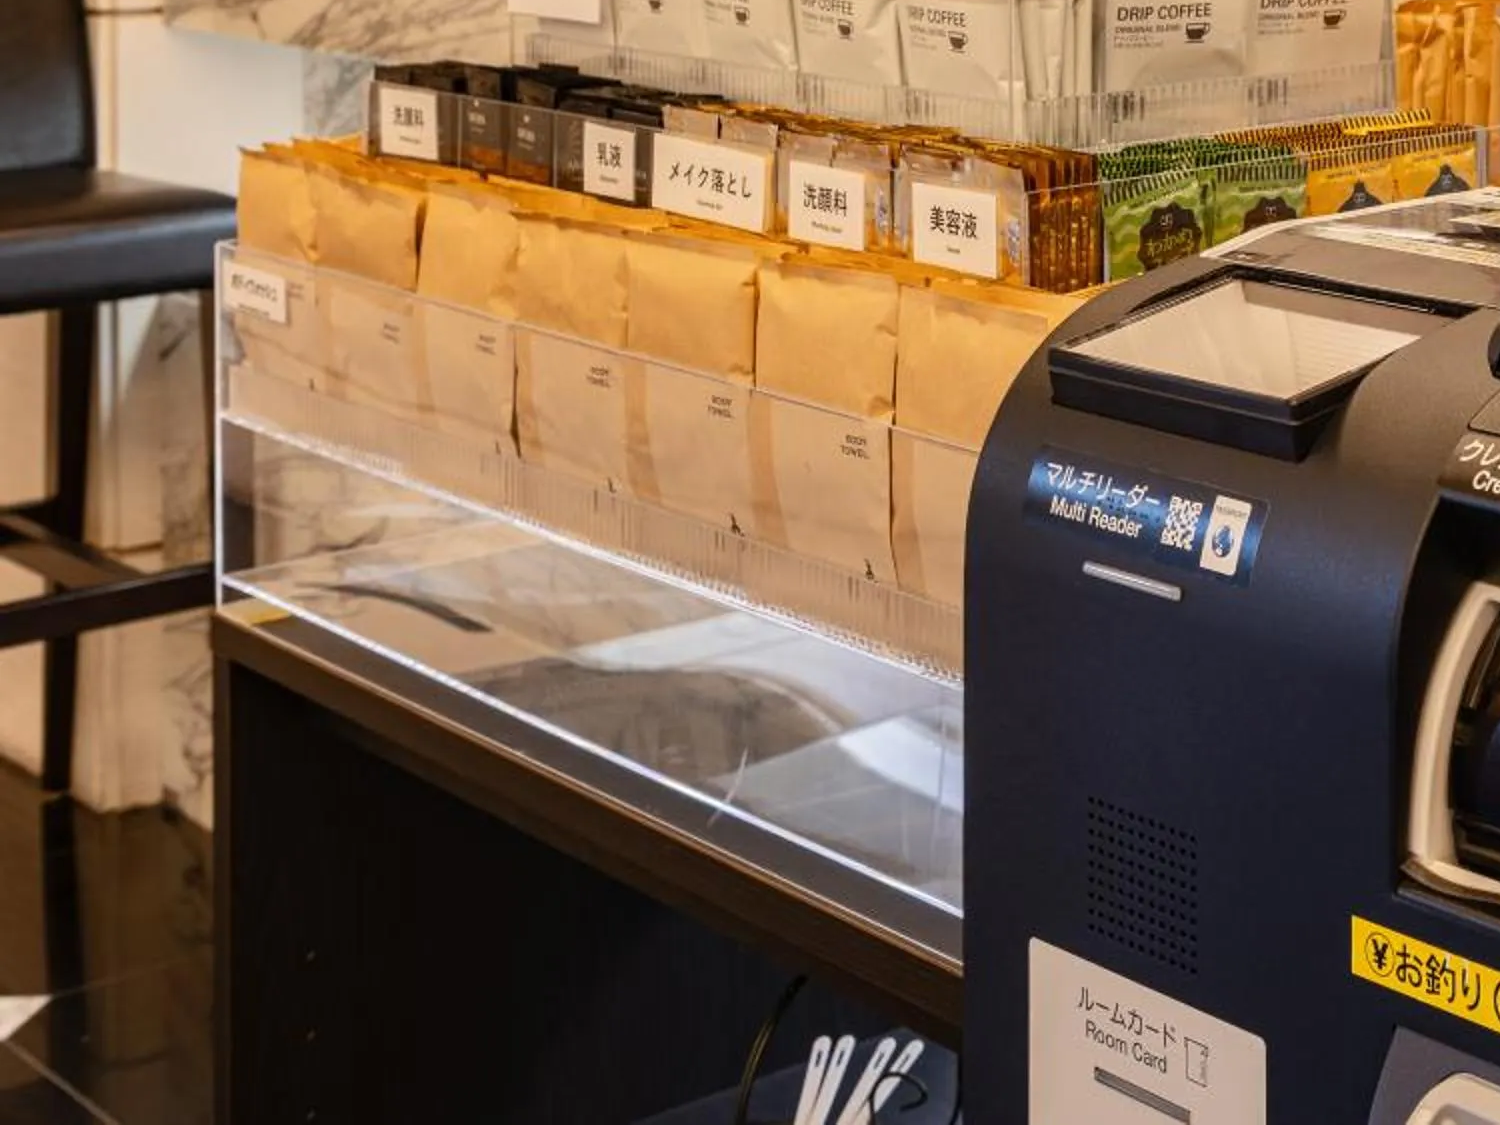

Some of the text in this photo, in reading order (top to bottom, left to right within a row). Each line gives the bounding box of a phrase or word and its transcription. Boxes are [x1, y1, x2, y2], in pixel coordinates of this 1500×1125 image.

[927, 7, 967, 29] COFFEE
[1115, 2, 1213, 23] DRIP COFFEE
[596, 141, 623, 169] 乳液
[668, 161, 753, 200] メイク落とし
[803, 180, 848, 217] 洗顔料
[929, 203, 980, 239] 美容液
[1047, 461, 1161, 509] マルチリーダー
[1049, 494, 1143, 539] Multi Reader
[1077, 985, 1177, 1048] ルームカード
[1084, 1018, 1168, 1074] Room Card
